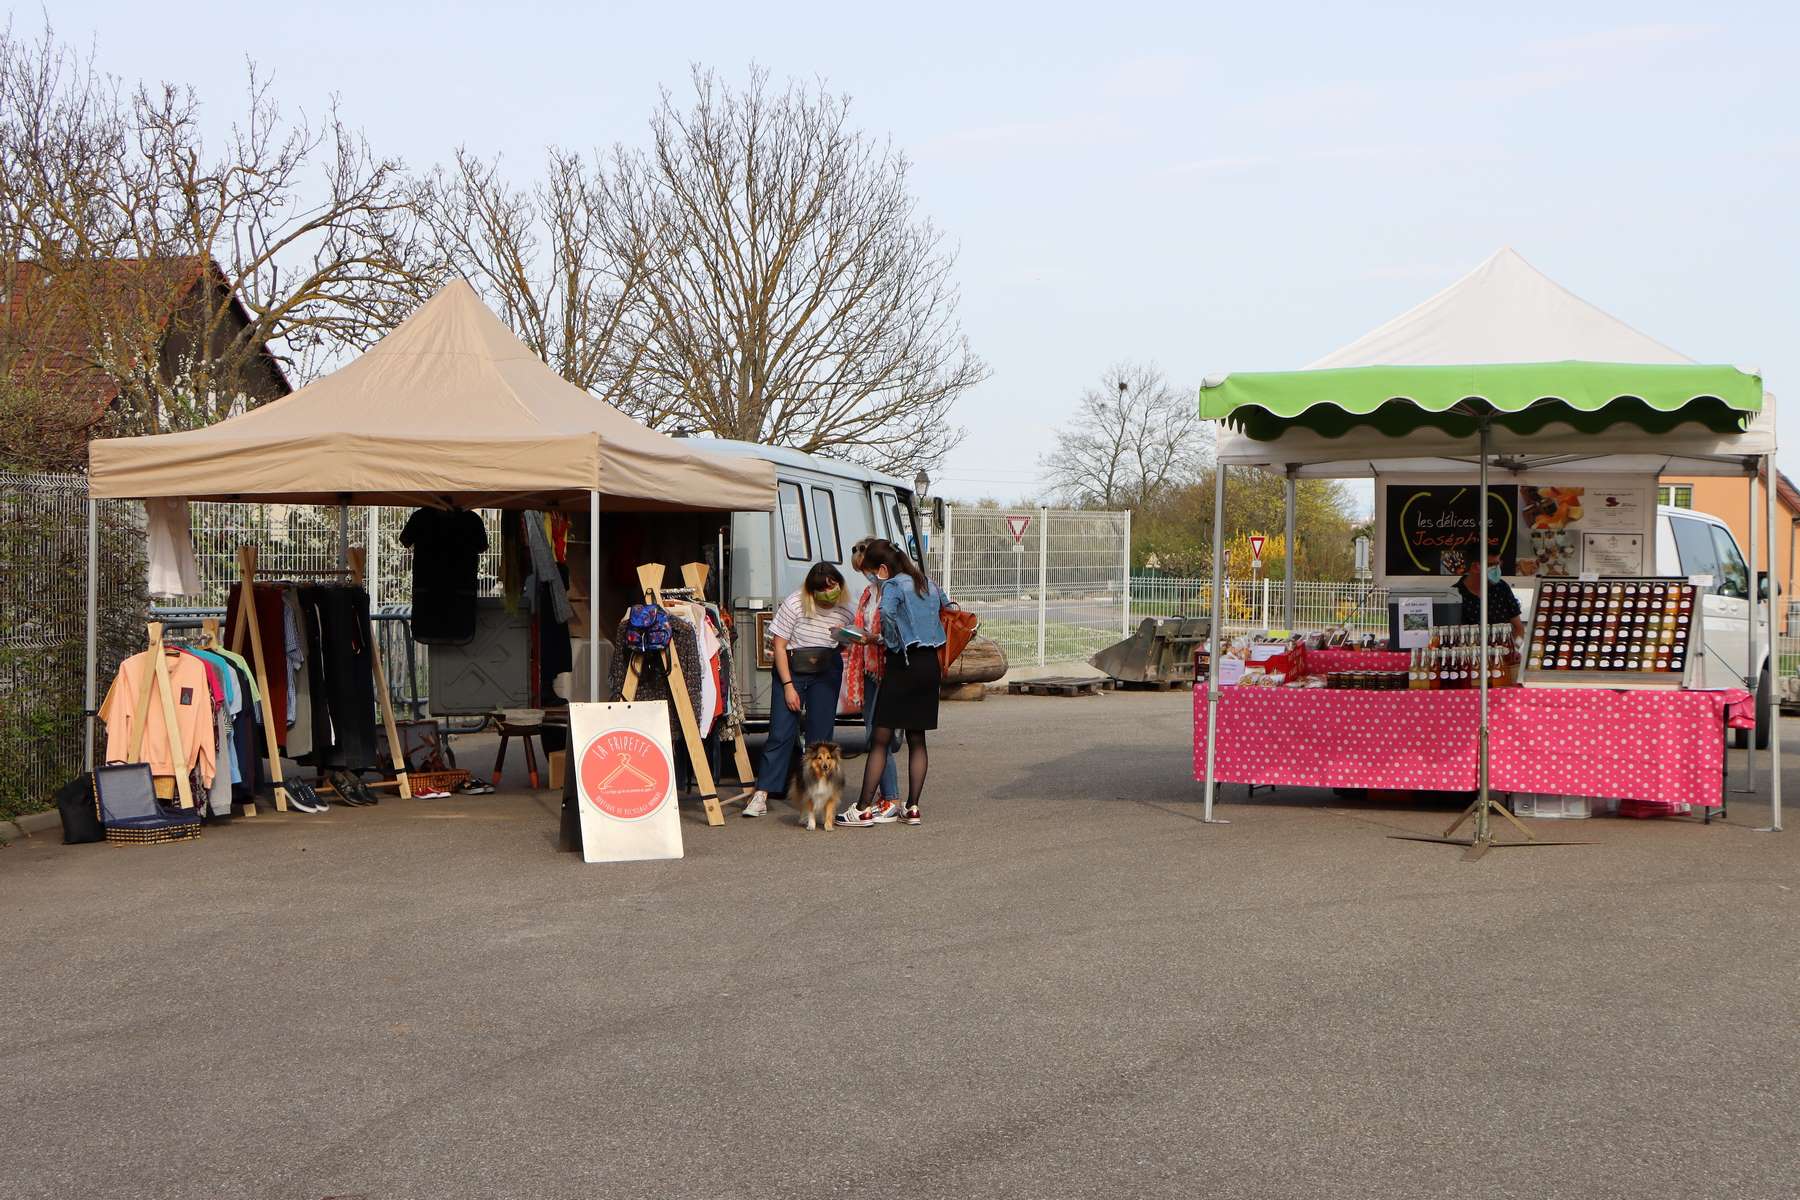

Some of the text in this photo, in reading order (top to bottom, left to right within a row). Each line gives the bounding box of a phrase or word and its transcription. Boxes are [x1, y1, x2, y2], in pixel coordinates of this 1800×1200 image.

[1417, 511, 1434, 528] les
[1436, 511, 1476, 528] délices
[592, 735, 651, 760] LA FRIPETTE
